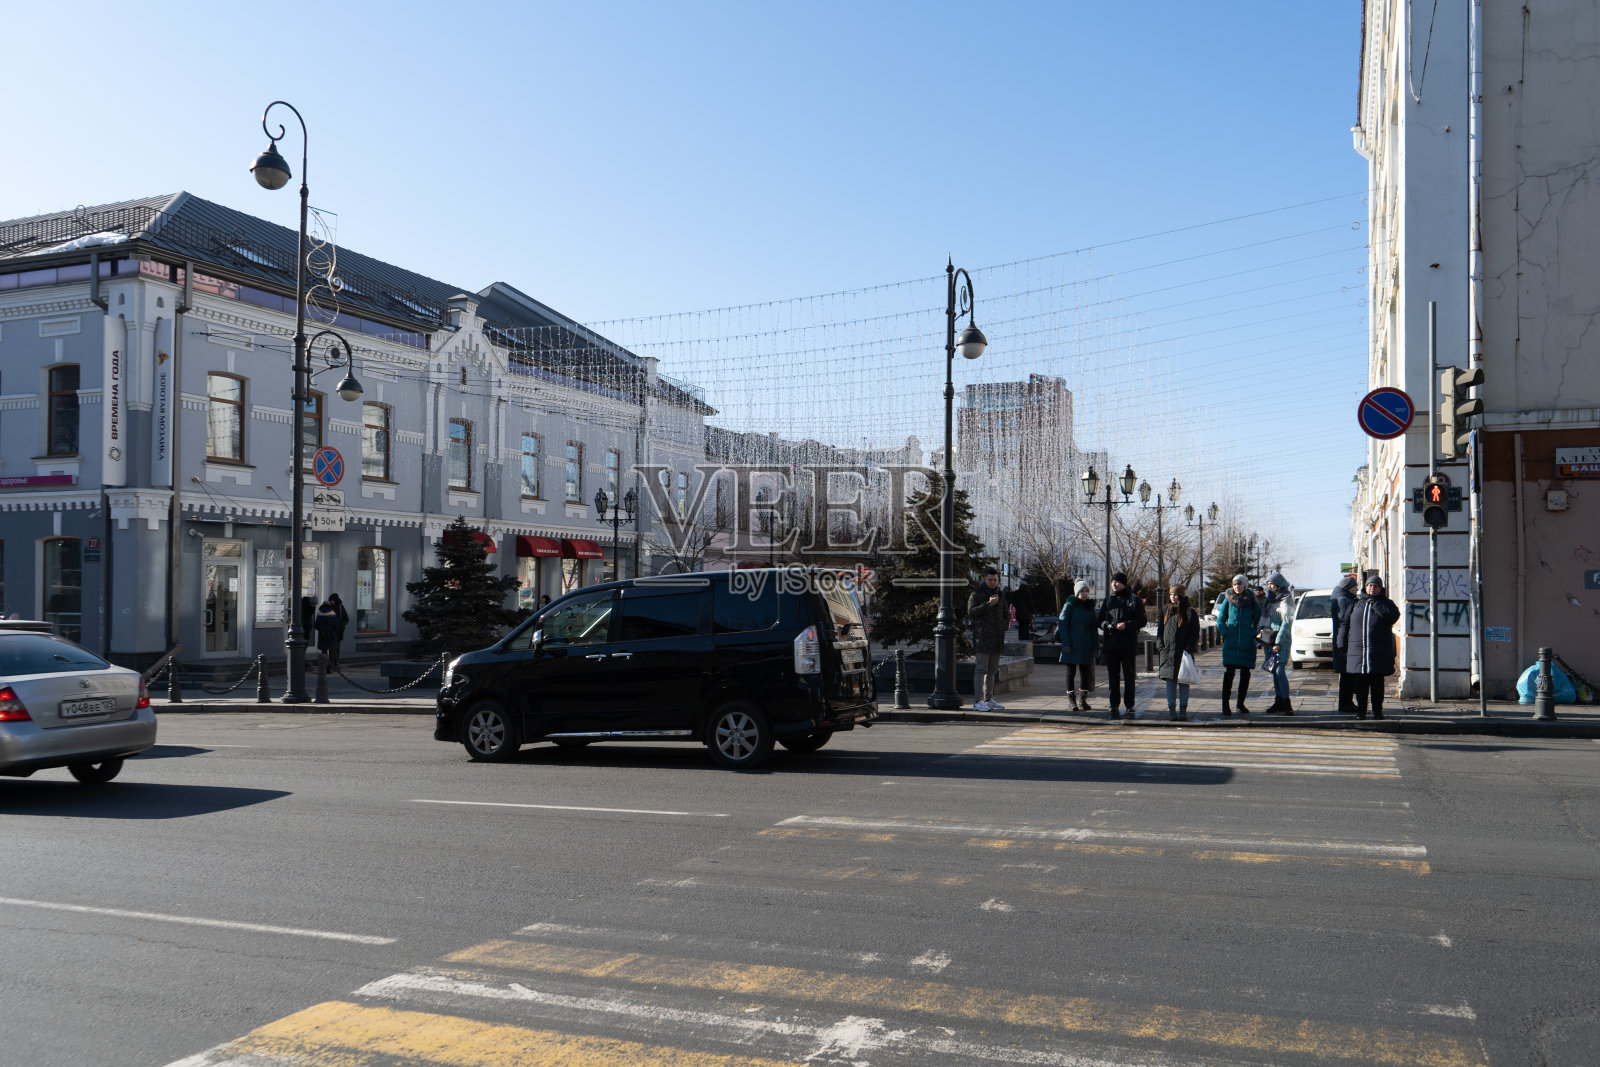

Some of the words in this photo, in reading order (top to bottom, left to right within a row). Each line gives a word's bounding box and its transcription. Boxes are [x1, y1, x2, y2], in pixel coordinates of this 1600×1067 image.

[111, 350, 119, 381] ГОДА
[111, 384, 119, 440] ВРЕМЕНА
[159, 371, 167, 415] ЗОЛОТАЯ
